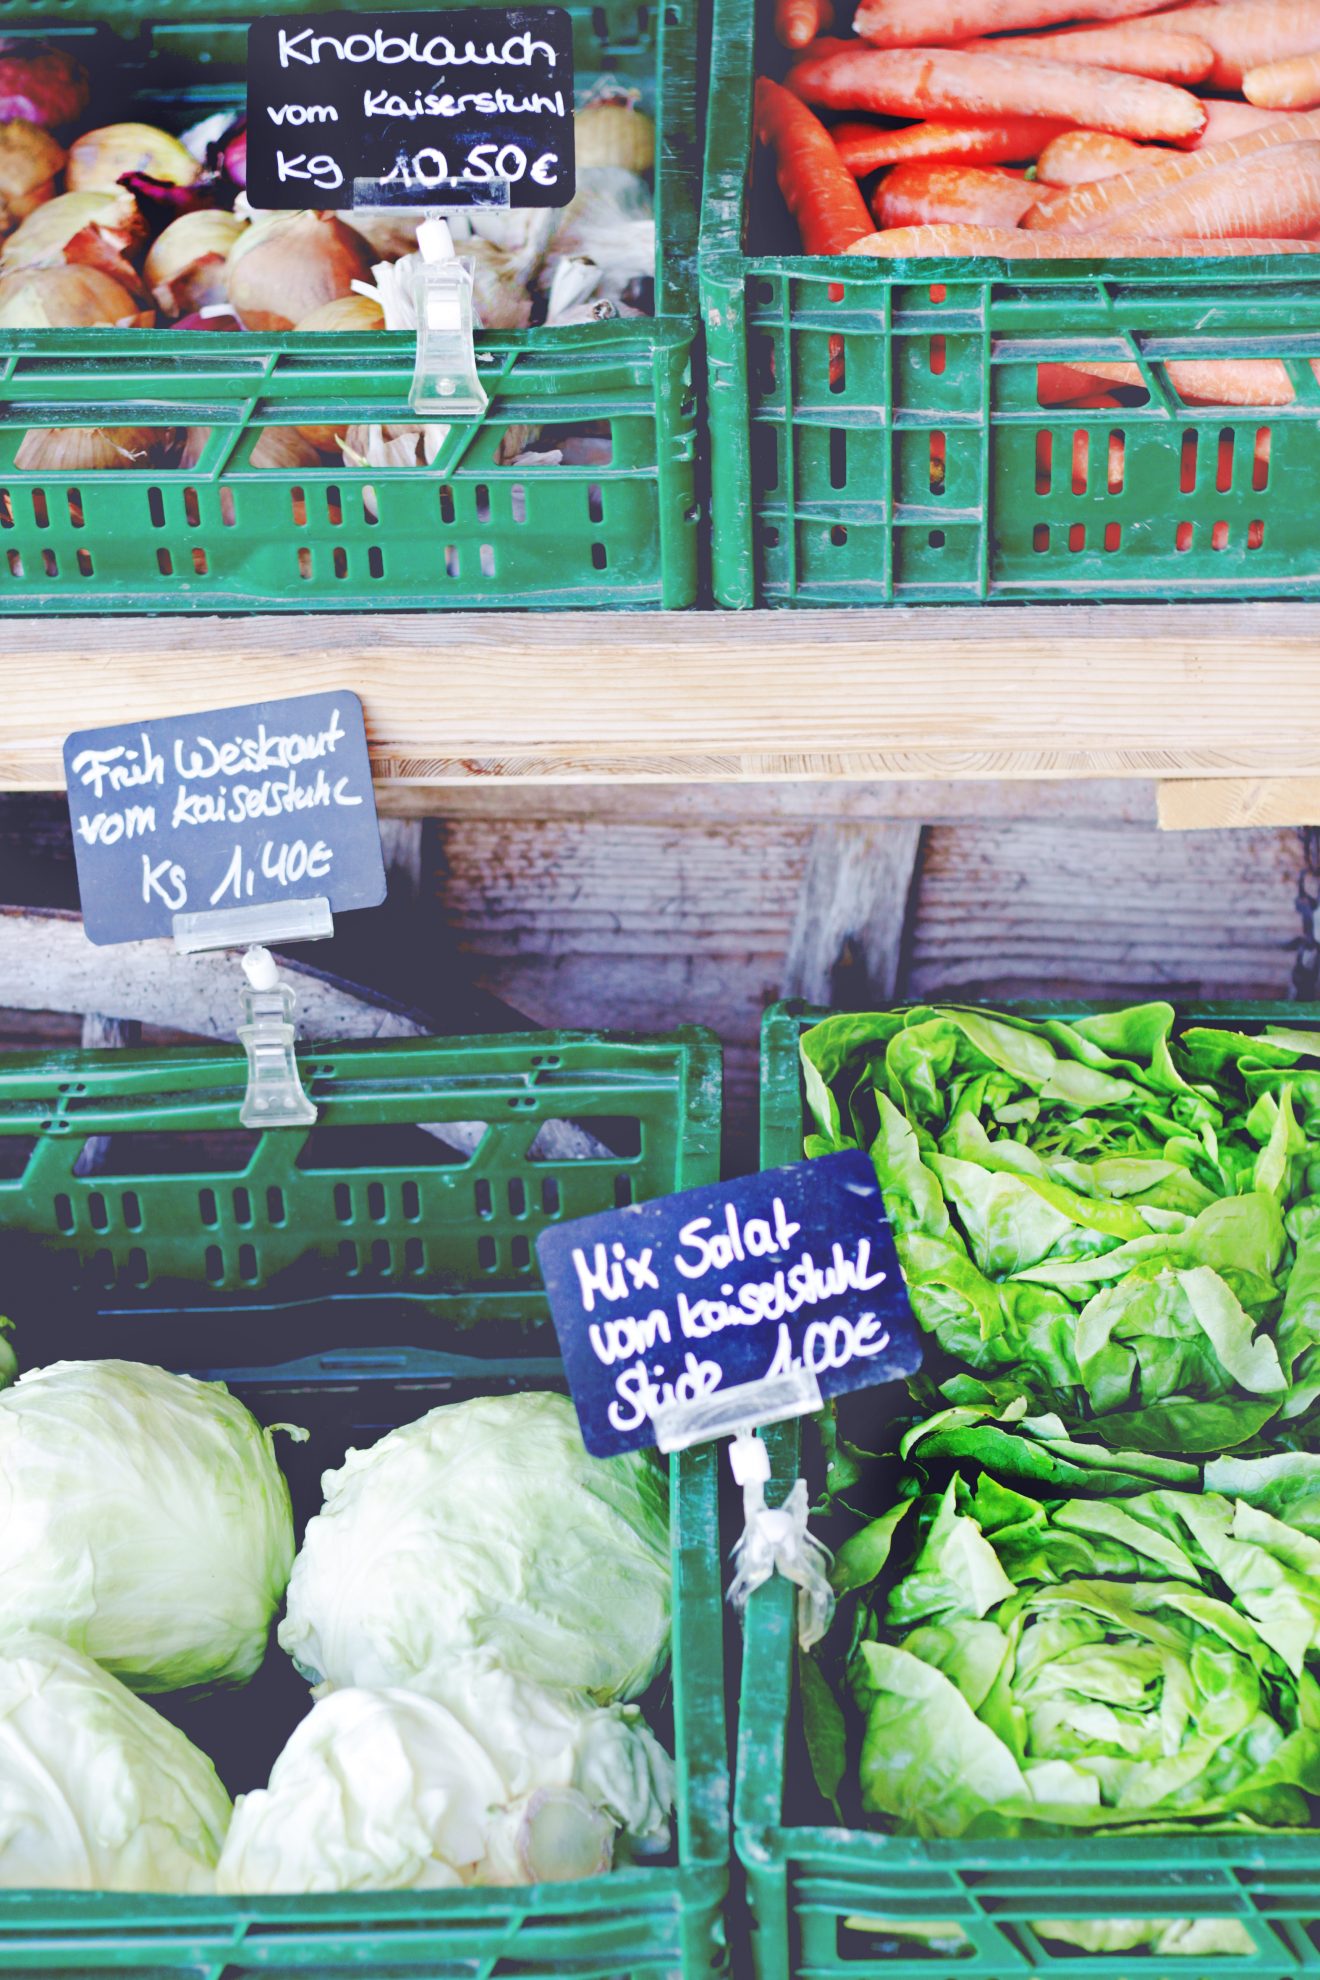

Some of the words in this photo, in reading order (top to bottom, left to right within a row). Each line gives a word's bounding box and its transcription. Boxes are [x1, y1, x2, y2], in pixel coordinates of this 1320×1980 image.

[278, 29, 557, 68] Knoblauch
[267, 103, 339, 126] vom
[363, 88, 566, 118] Kaiserstuhl
[276, 150, 343, 189] Kg
[77, 804, 156, 846] vom
[572, 1242, 660, 1312] Mix
[674, 1197, 801, 1279] Salat
[588, 1309, 672, 1365] vom
